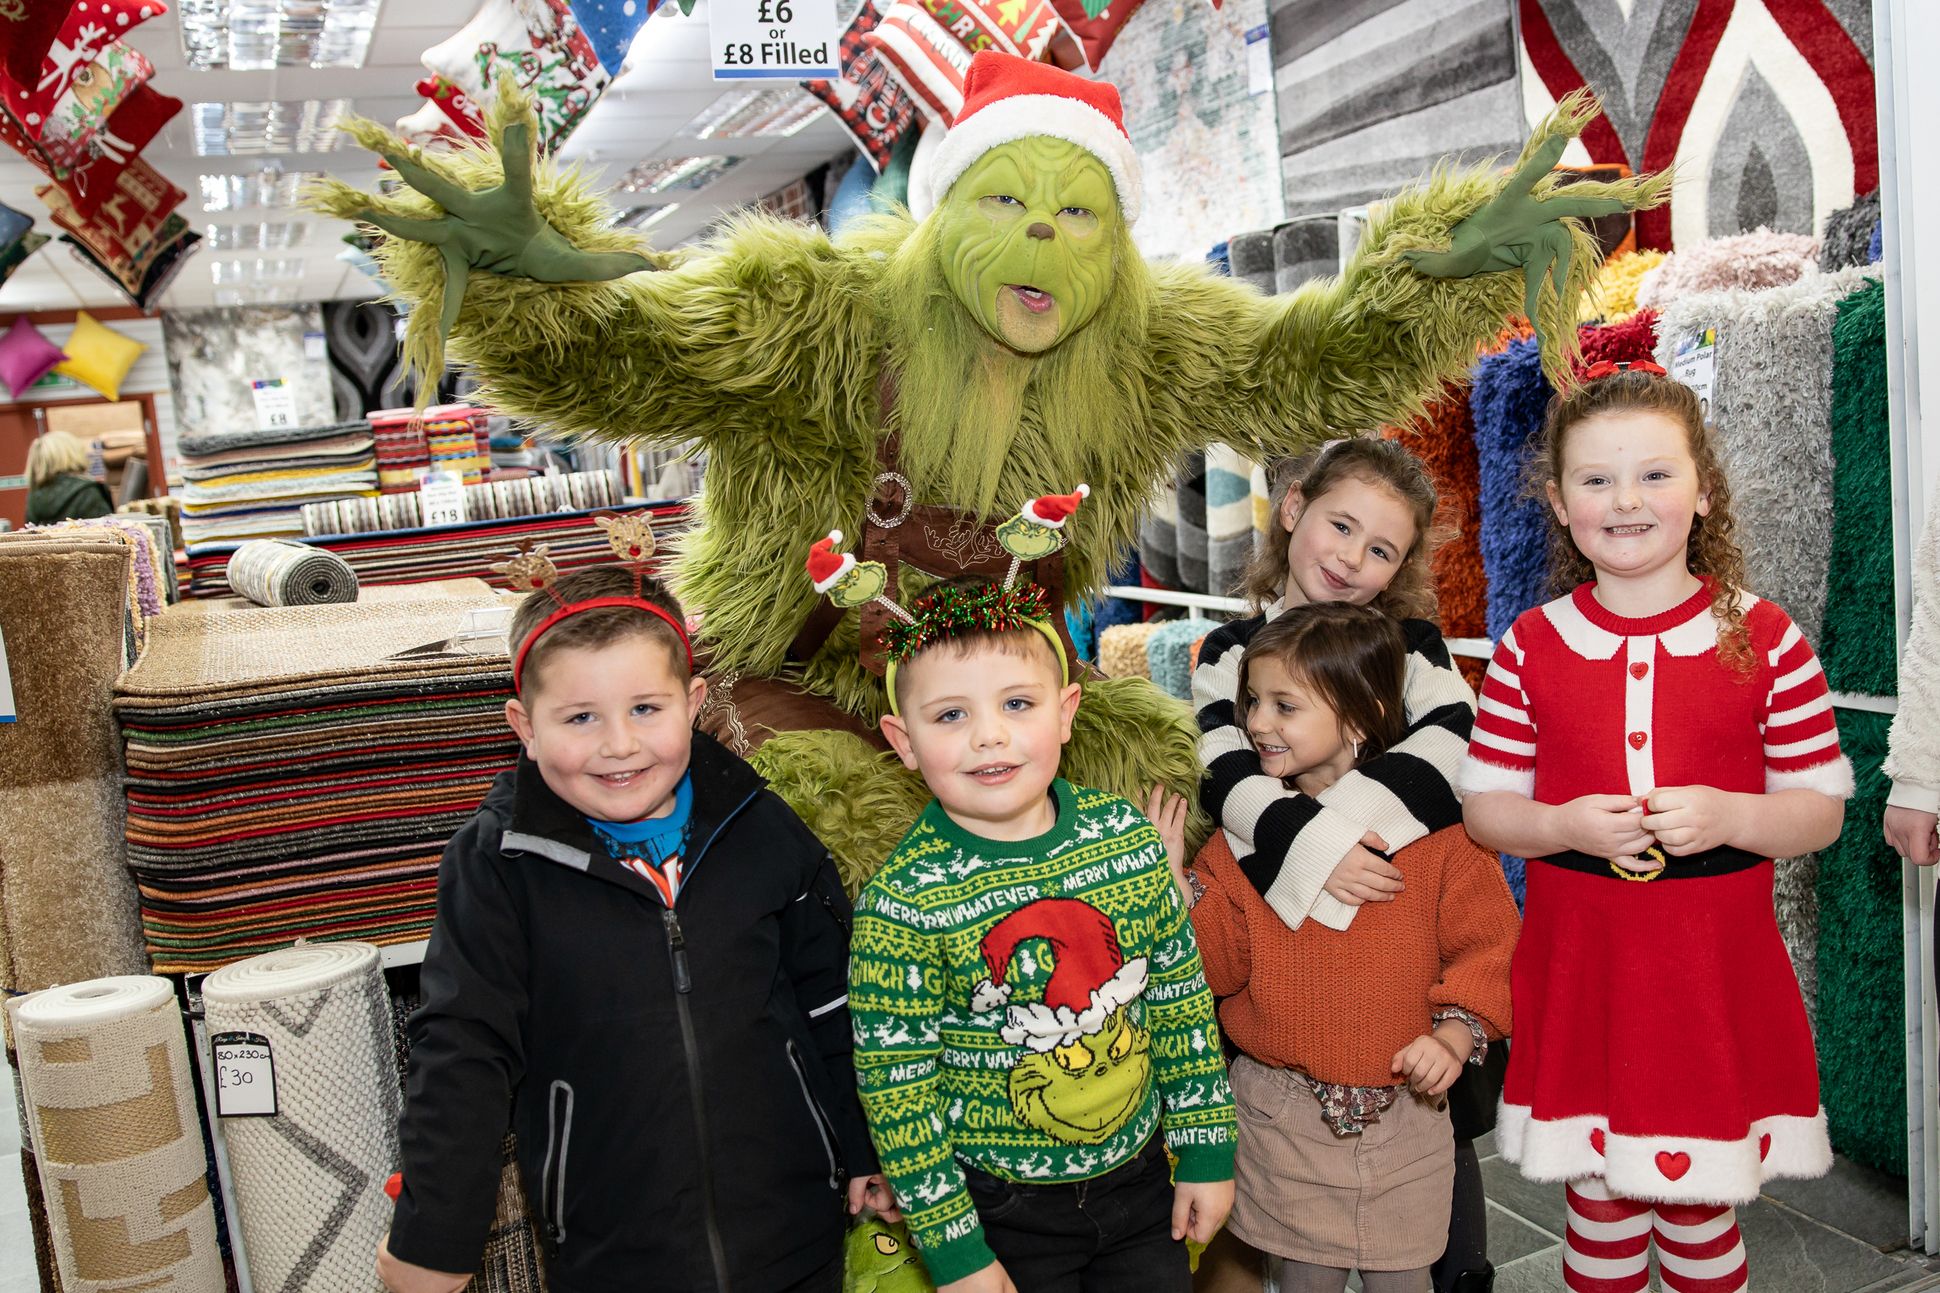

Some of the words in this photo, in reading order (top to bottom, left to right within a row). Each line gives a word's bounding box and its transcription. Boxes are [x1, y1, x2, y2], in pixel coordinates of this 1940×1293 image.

[758, 0, 793, 23] £6
[769, 29, 786, 39] or
[724, 43, 754, 64] £8
[761, 42, 828, 64] Filled
[1675, 356, 1696, 368] Medium
[1696, 350, 1712, 360] Polar
[1685, 368, 1696, 377] Rug
[431, 509, 457, 524] £18
[1062, 861, 1109, 892] MERRY
[949, 885, 1041, 926] WHATEVER
[942, 1049, 981, 1069] ERRY
[1165, 1125, 1228, 1149] WHATEVER
